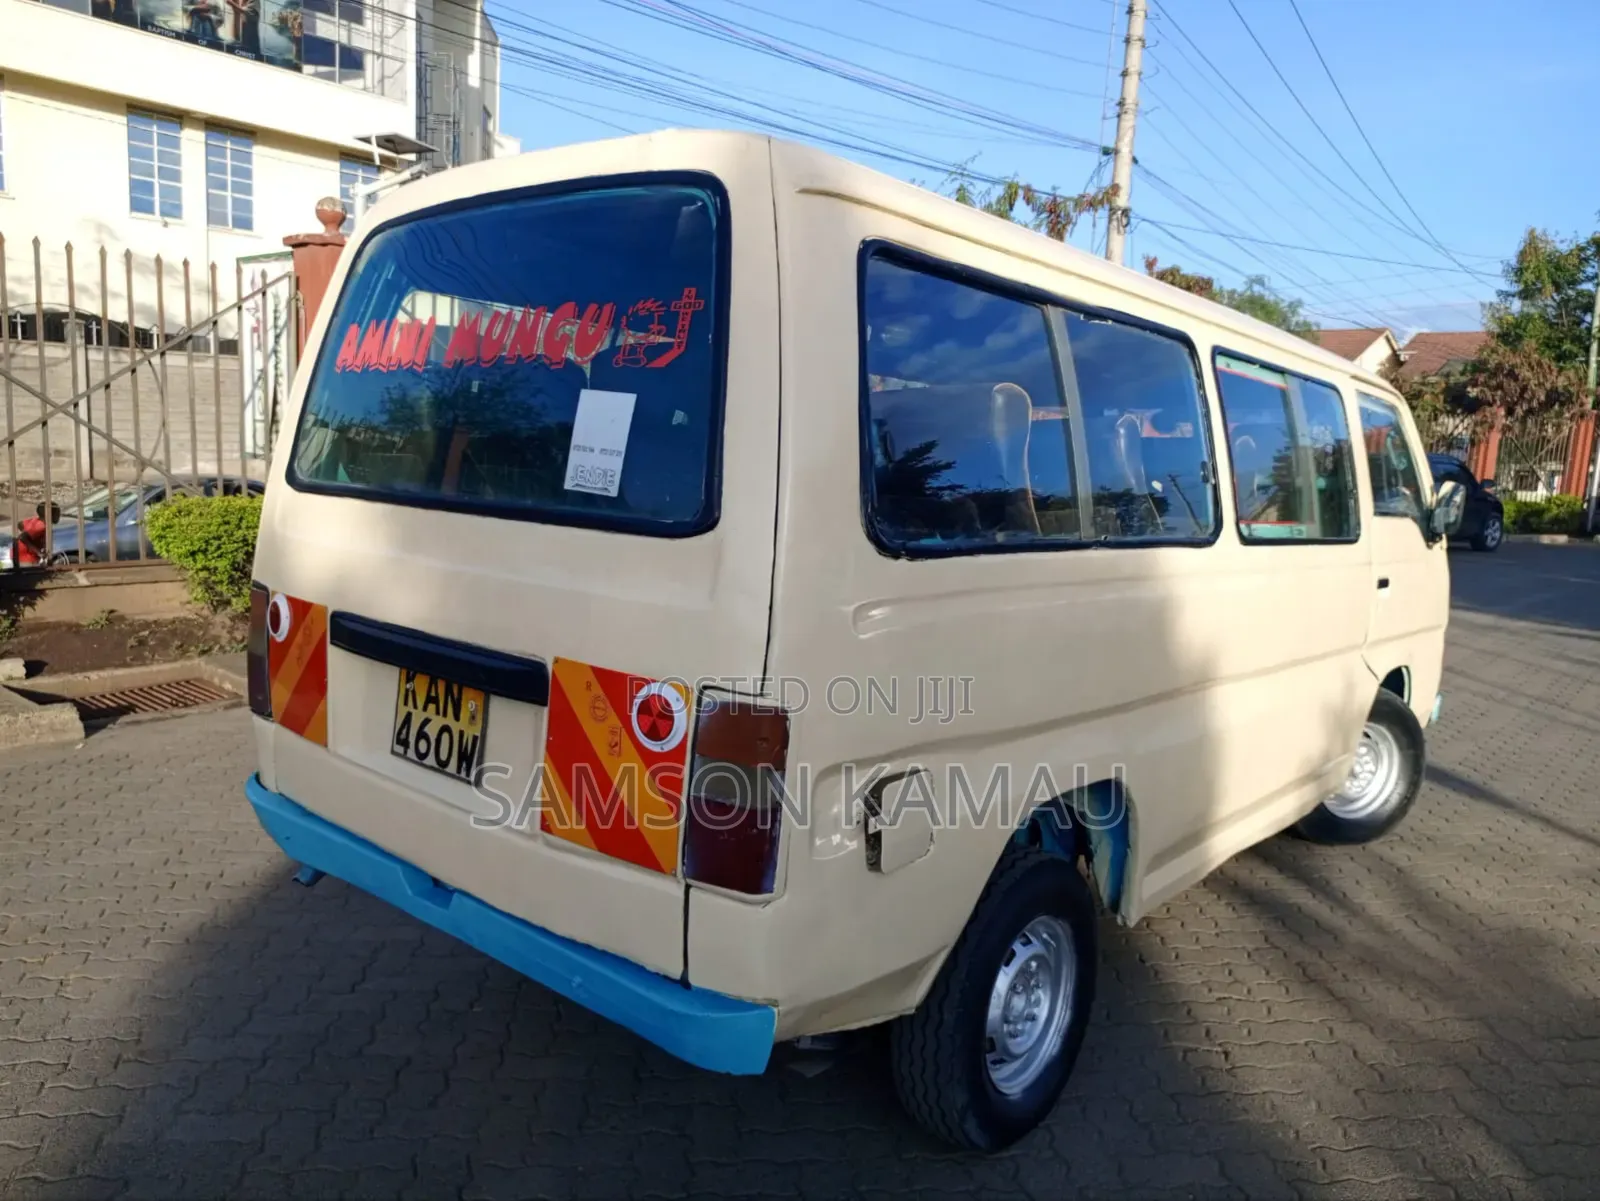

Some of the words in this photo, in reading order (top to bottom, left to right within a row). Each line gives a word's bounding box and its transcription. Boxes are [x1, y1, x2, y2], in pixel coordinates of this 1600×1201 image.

[147, 25, 176, 38] BAPTISM
[234, 49, 256, 59] CHRIST
[673, 301, 702, 310] GOD
[335, 315, 436, 373] AMINI
[442, 301, 616, 369] MUNGU
[404, 668, 462, 722] KAN
[396, 711, 479, 778] 460W
